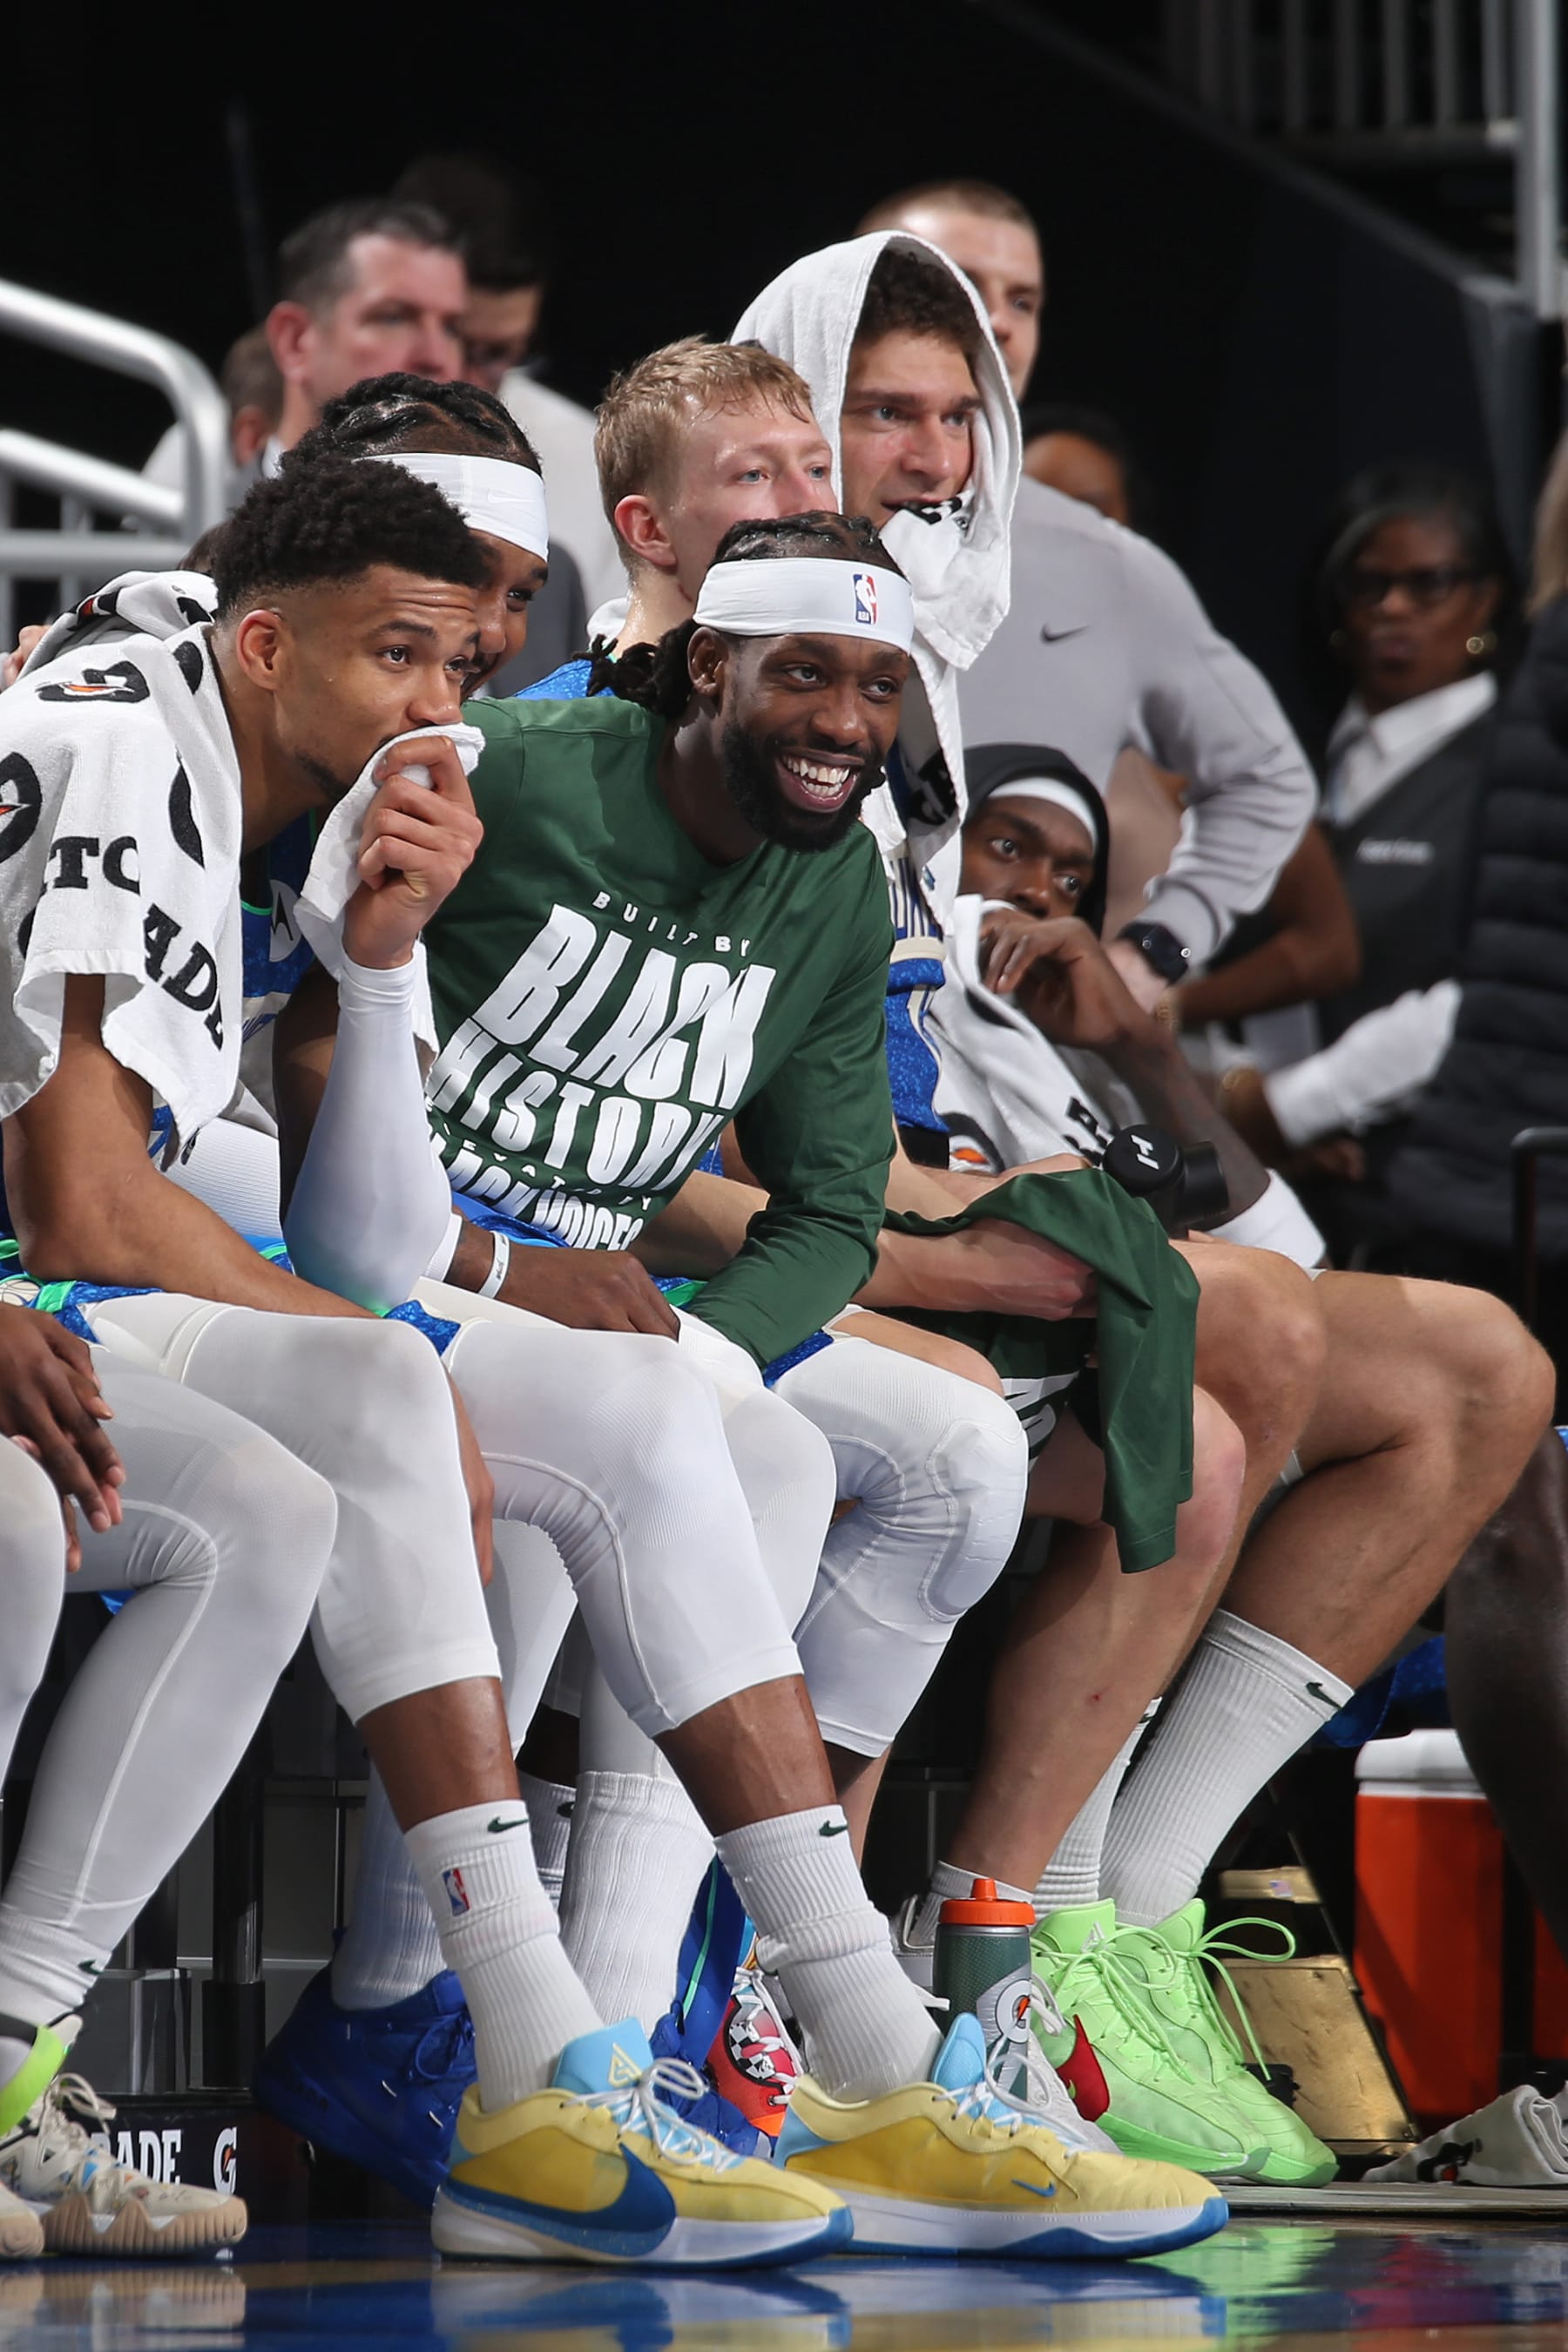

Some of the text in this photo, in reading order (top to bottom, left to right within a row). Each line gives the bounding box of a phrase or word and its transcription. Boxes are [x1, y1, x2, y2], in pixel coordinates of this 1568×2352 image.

[473, 902, 777, 1110] BLACK
[592, 891, 752, 956] BUILT BY
[425, 1017, 725, 1191] HISTORY
